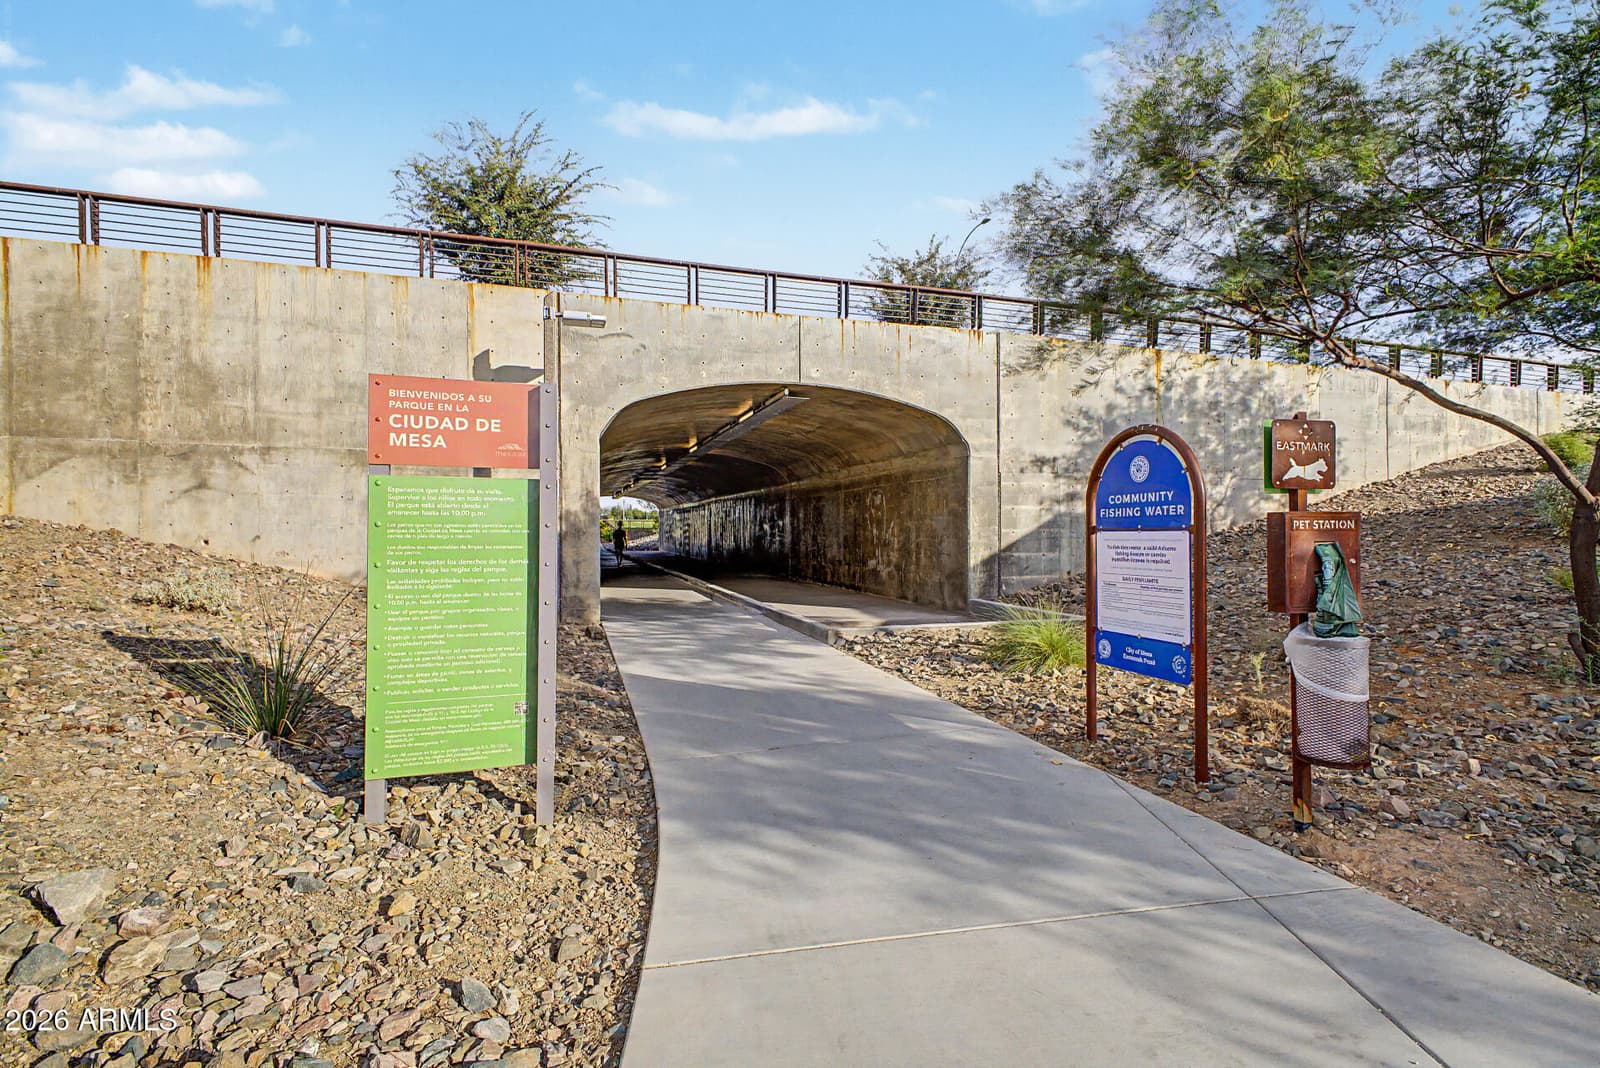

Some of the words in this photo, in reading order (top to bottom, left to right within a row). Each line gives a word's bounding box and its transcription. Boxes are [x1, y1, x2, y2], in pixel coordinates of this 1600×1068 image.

[389, 389, 464, 401] BIENVENIDOS
[478, 394, 492, 403] SU
[389, 400, 434, 410] PARQUE
[438, 403, 452, 412] EN
[456, 404, 469, 412] LA
[389, 414, 469, 431] CIUDAD
[476, 418, 502, 432] DE
[389, 432, 447, 448] MESA
[1276, 441, 1330, 452] EASTMARK
[1108, 491, 1174, 504] COMMUNITY
[1100, 507, 1140, 518] FISHING
[1145, 505, 1184, 516] WATER
[1293, 520, 1310, 529] PET
[1313, 520, 1355, 529] STATION
